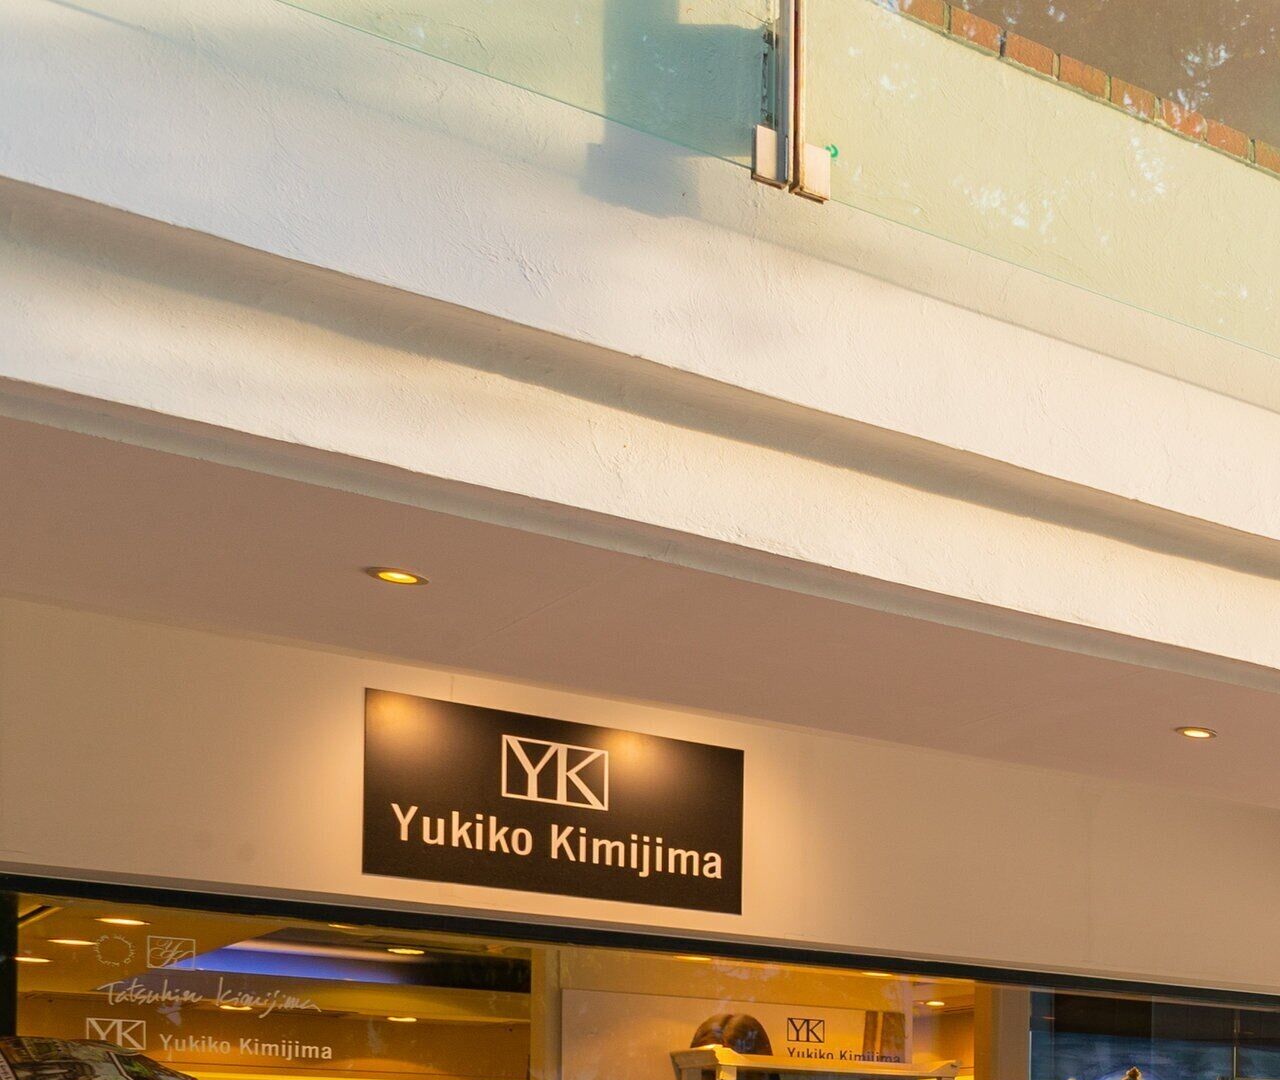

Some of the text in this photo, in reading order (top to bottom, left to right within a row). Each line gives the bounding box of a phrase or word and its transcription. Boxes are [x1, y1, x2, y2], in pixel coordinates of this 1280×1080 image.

[502, 735, 608, 811] YK
[391, 803, 722, 879] Yukiko Kimijima
[87, 1018, 146, 1050] YK
[160, 1033, 332, 1060] Yukiko Kimijima
[787, 1018, 824, 1043] YK
